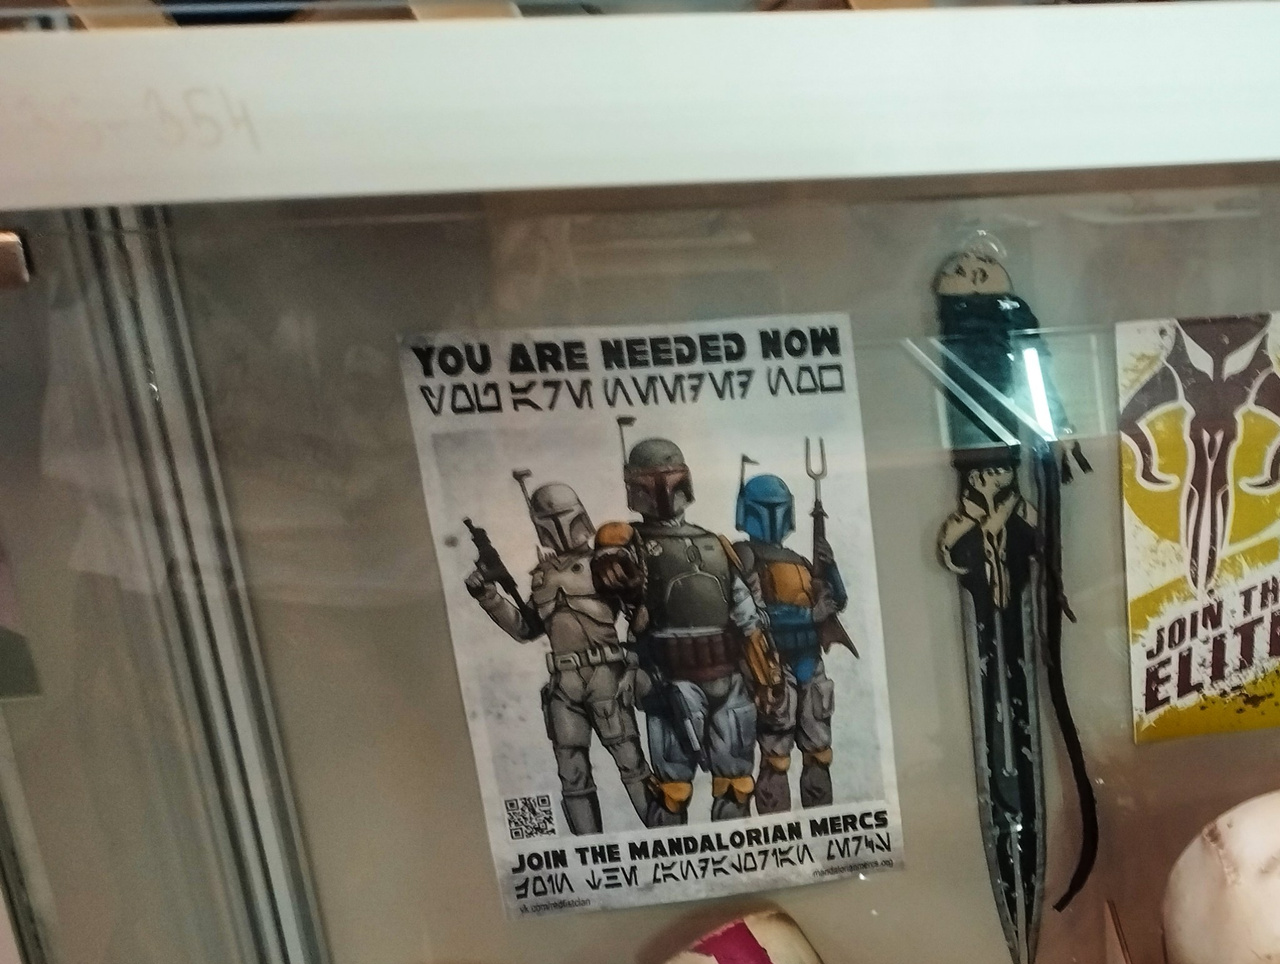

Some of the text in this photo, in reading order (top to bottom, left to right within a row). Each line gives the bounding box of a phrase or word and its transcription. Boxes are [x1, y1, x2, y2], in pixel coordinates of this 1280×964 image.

[411, 326, 842, 379] YOU ARE NEEDED NOW
[1146, 599, 1224, 661] JOIN
[511, 848, 568, 875] JOIN
[574, 842, 625, 865] THE
[628, 820, 805, 861] MANDALORIAN
[810, 809, 890, 838] MERCS
